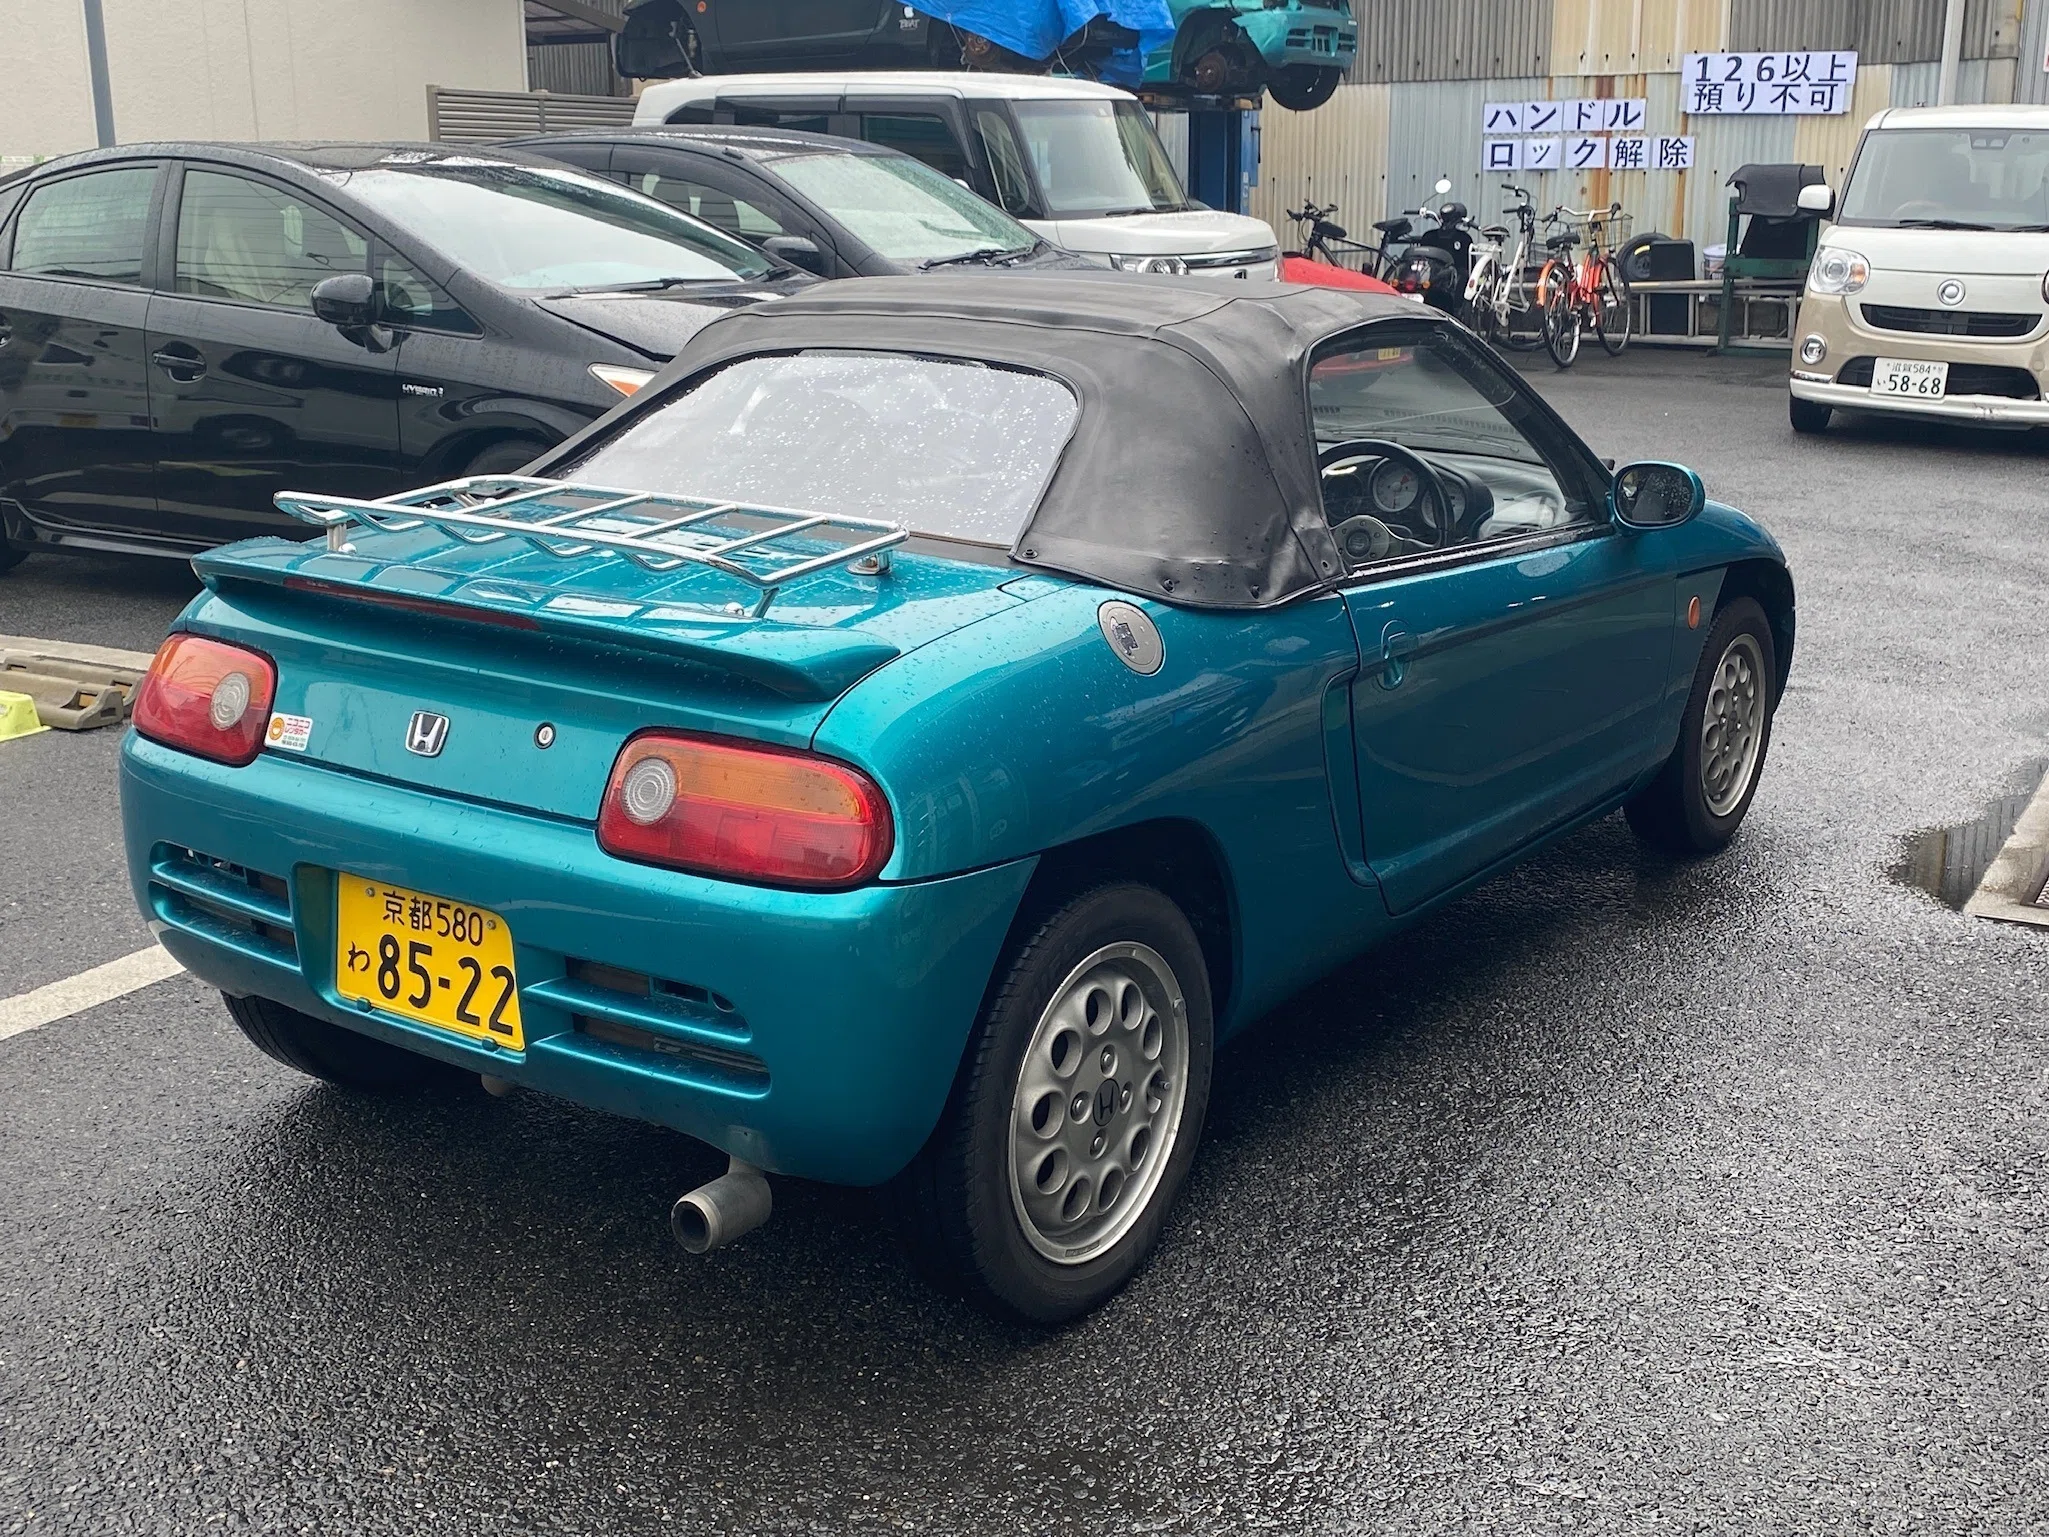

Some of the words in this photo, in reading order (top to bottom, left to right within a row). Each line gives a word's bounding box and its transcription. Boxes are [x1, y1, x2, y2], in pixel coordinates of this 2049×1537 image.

[1695, 53, 1848, 83] 126以上
[1693, 82, 1839, 112] 預り不可
[1486, 100, 1643, 131] ハンドル
[1489, 138, 1688, 168] ロック解除
[1888, 373, 1941, 395] 58-68
[382, 890, 483, 947] 京都580
[347, 941, 370, 972] わ
[377, 933, 515, 1036] 85-22
